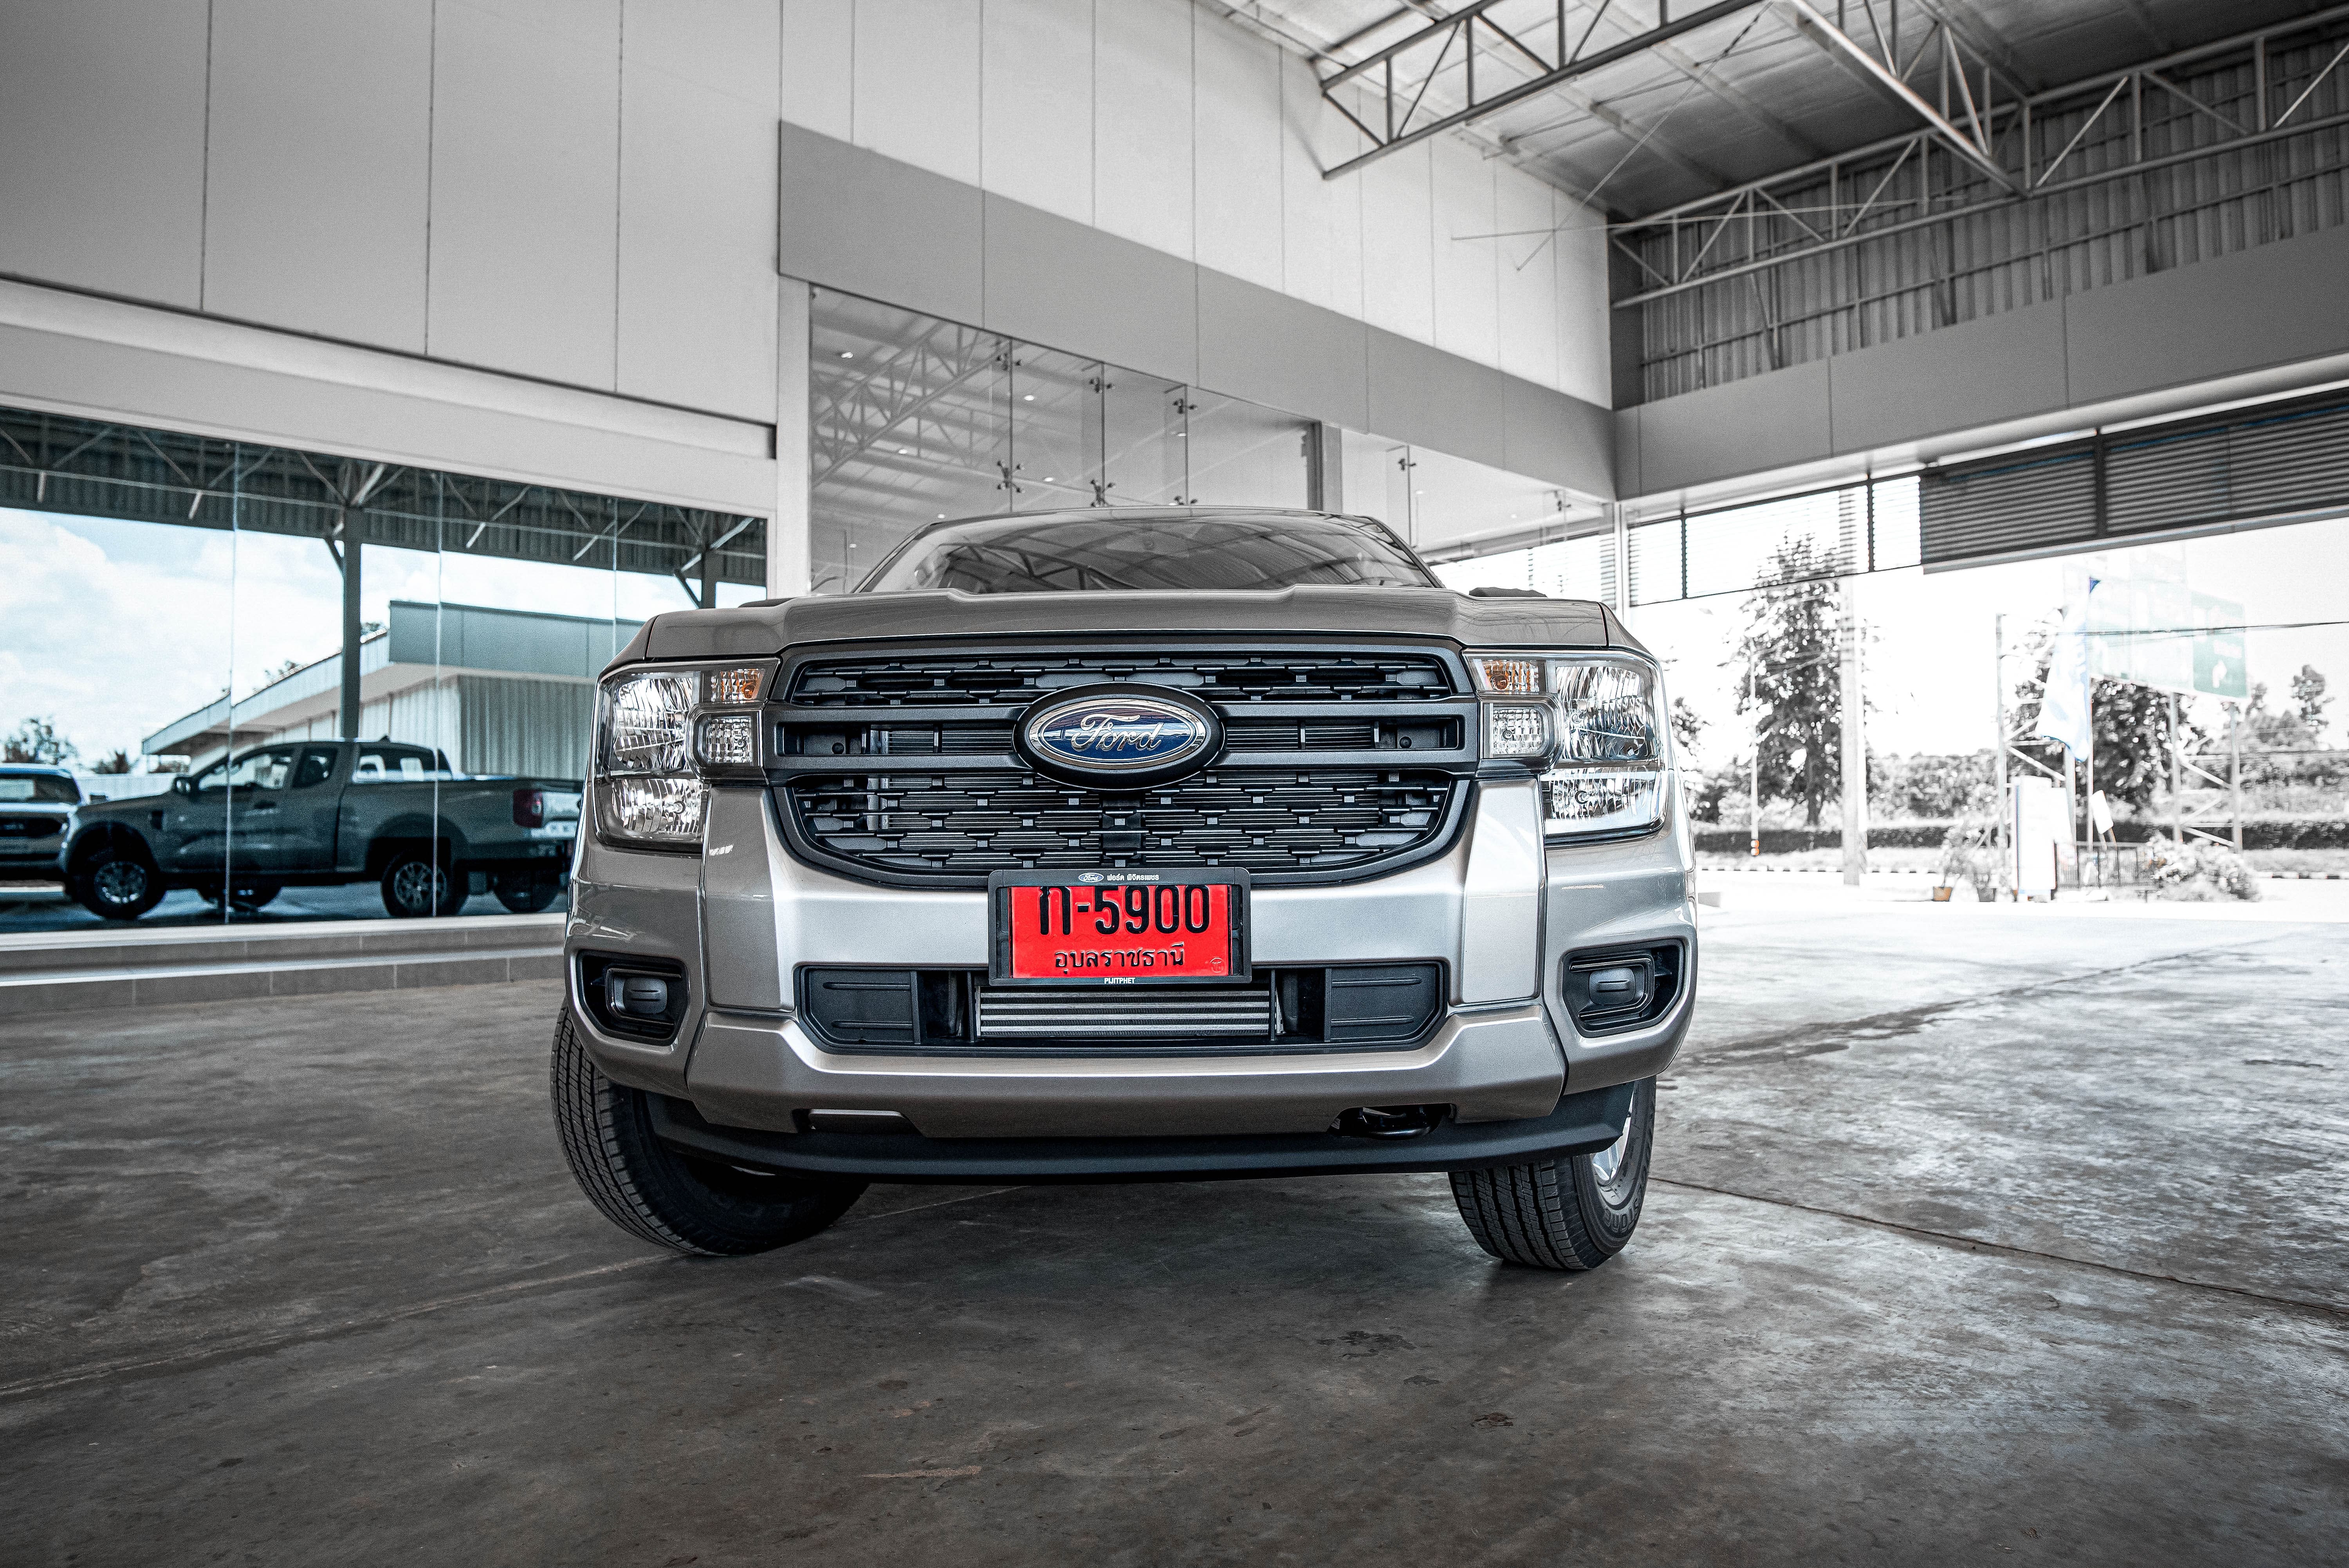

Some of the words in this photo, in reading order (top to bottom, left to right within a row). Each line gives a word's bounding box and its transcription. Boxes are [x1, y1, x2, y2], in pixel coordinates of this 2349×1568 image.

[1071, 713, 1164, 751] Ford
[1055, 942, 1184, 974] อุบลราชธานี
